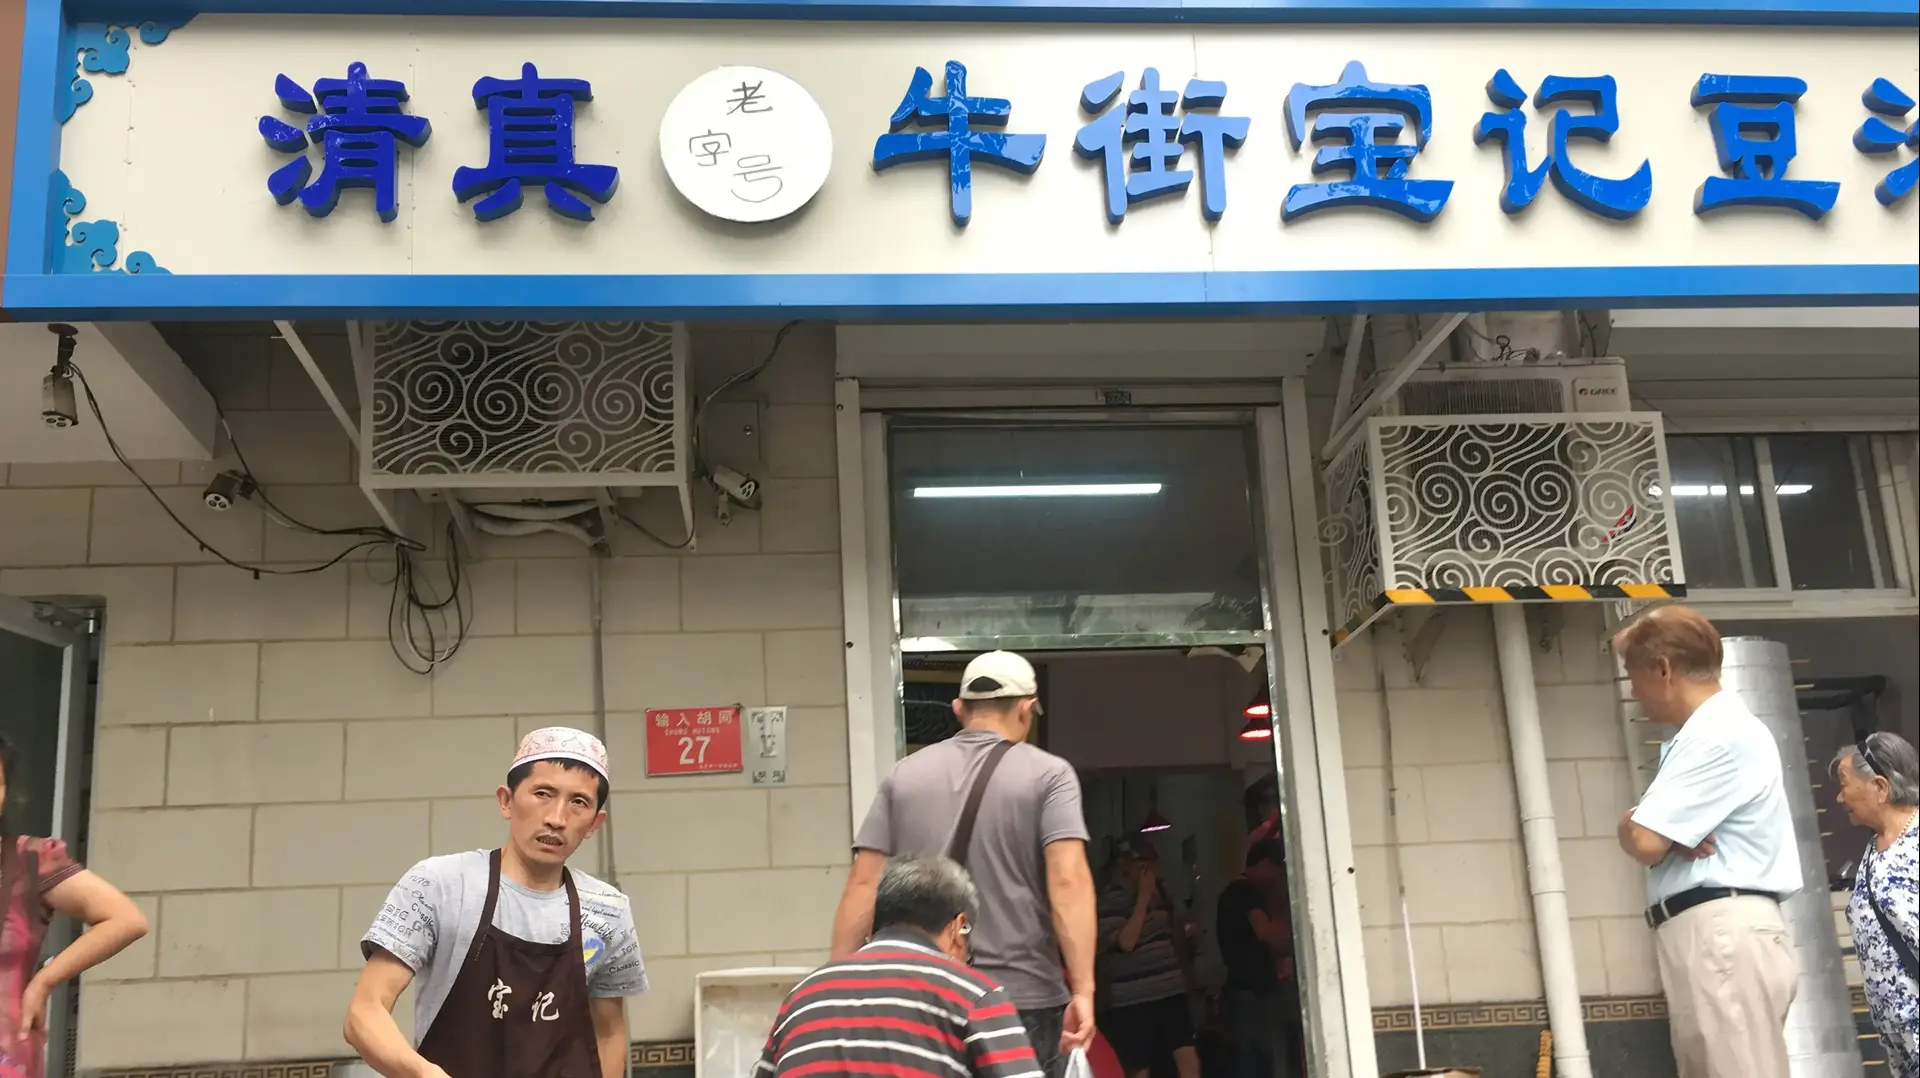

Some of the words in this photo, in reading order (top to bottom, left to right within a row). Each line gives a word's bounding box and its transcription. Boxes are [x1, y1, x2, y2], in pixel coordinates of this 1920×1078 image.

[258, 61, 620, 223] 清真
[688, 80, 785, 203] 老字号
[1590, 387, 1618, 396] GREE
[655, 710, 733, 727] 输入胡同
[678, 735, 711, 765] 27
[487, 977, 560, 1022] 宝记
